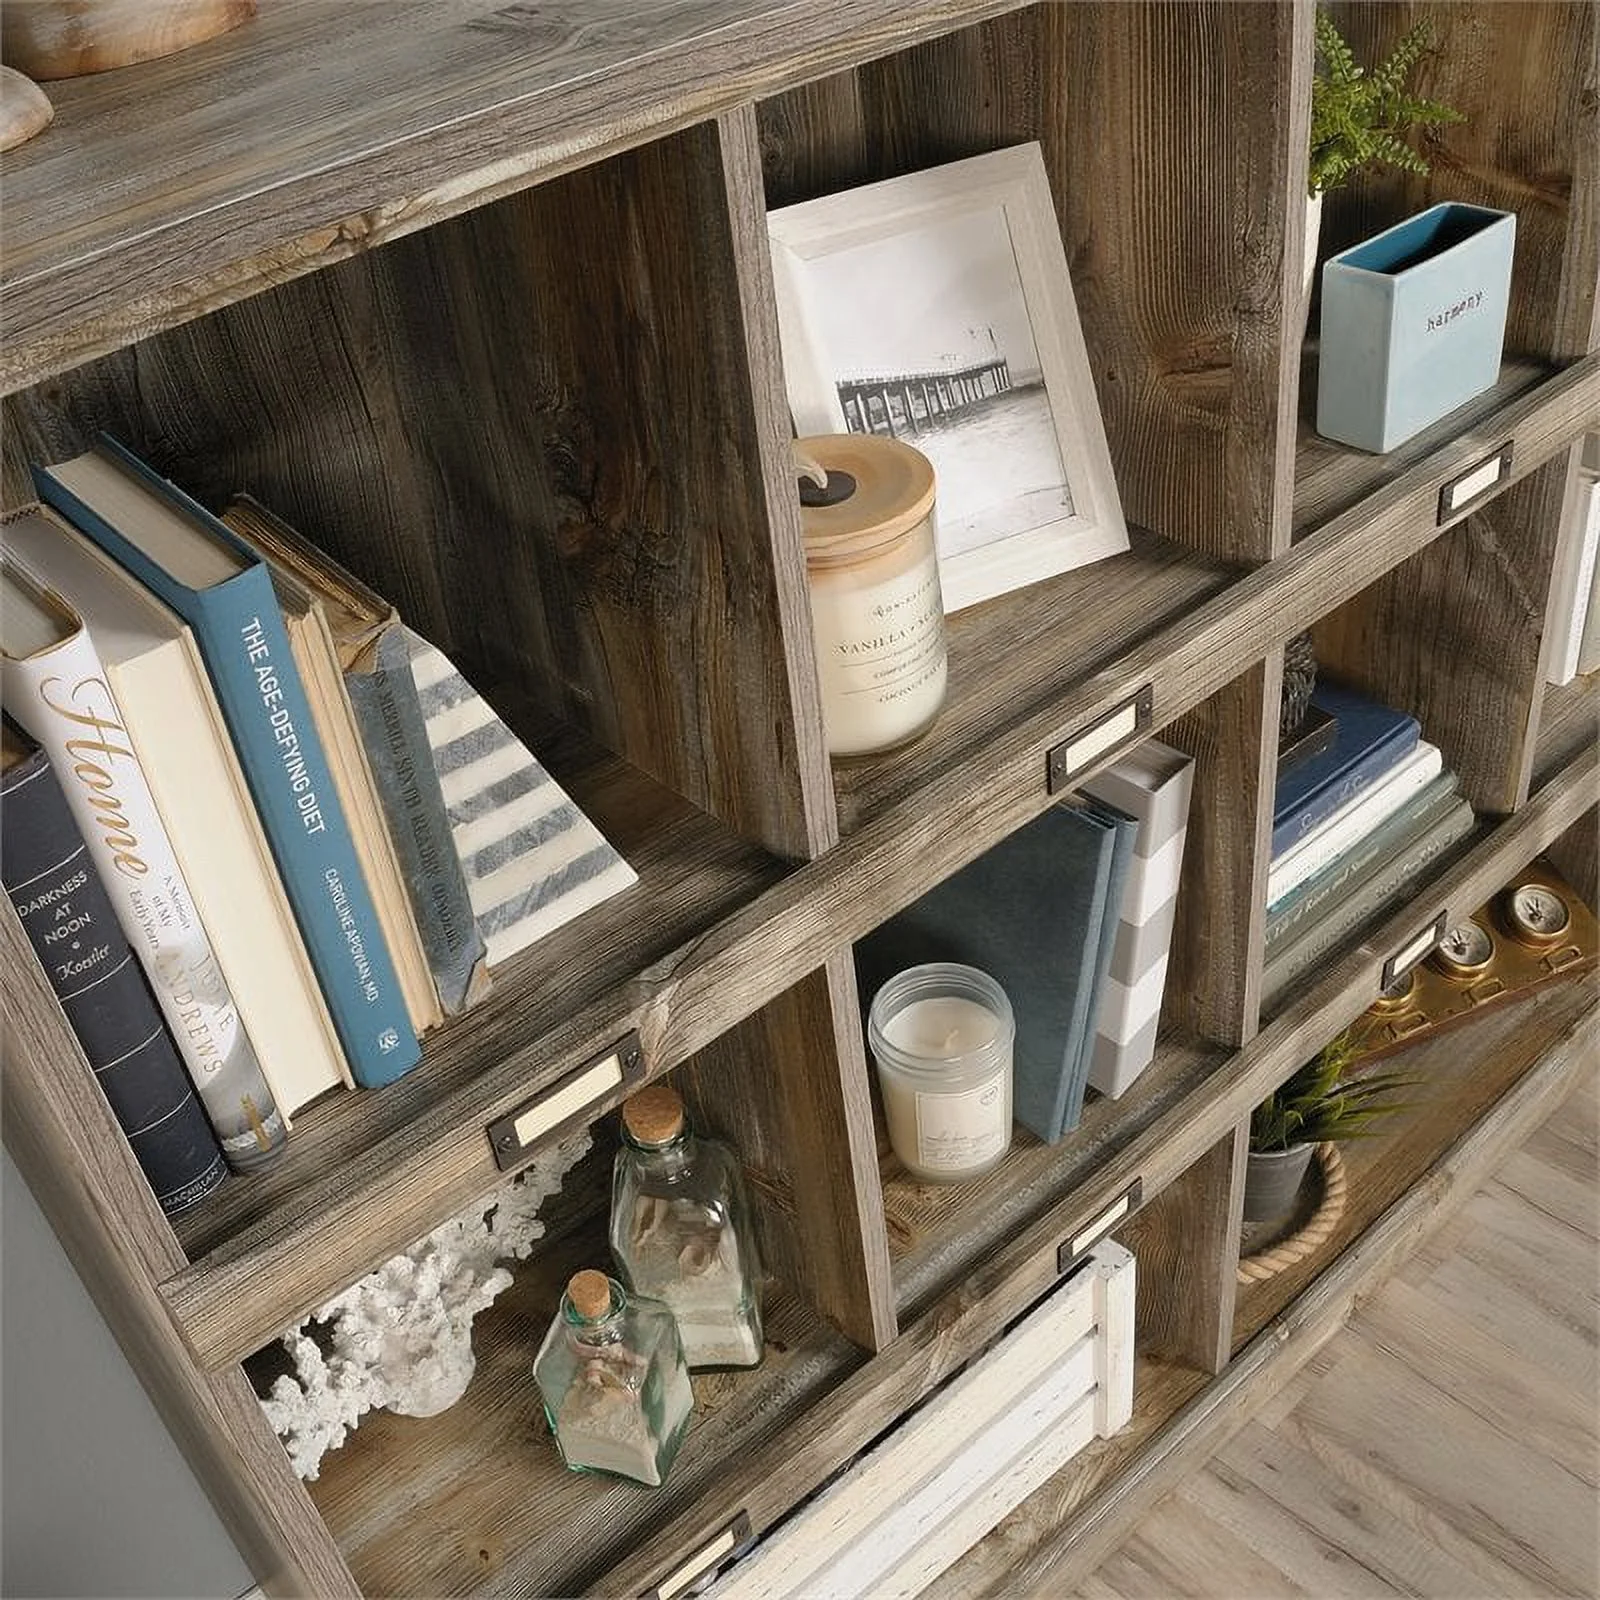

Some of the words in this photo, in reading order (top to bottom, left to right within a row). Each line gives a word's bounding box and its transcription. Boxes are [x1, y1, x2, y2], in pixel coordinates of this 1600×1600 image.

[1426, 291, 1483, 332] harmony
[240, 616, 269, 664] THE
[254, 665, 311, 792] AGE-DEFYING
[39, 677, 149, 880] Home
[297, 791, 326, 835] DIET
[17, 870, 88, 917] DARKNESS
[55, 902, 72, 921] AT
[324, 867, 355, 928] CAROLINE
[44, 912, 91, 944] NOON
